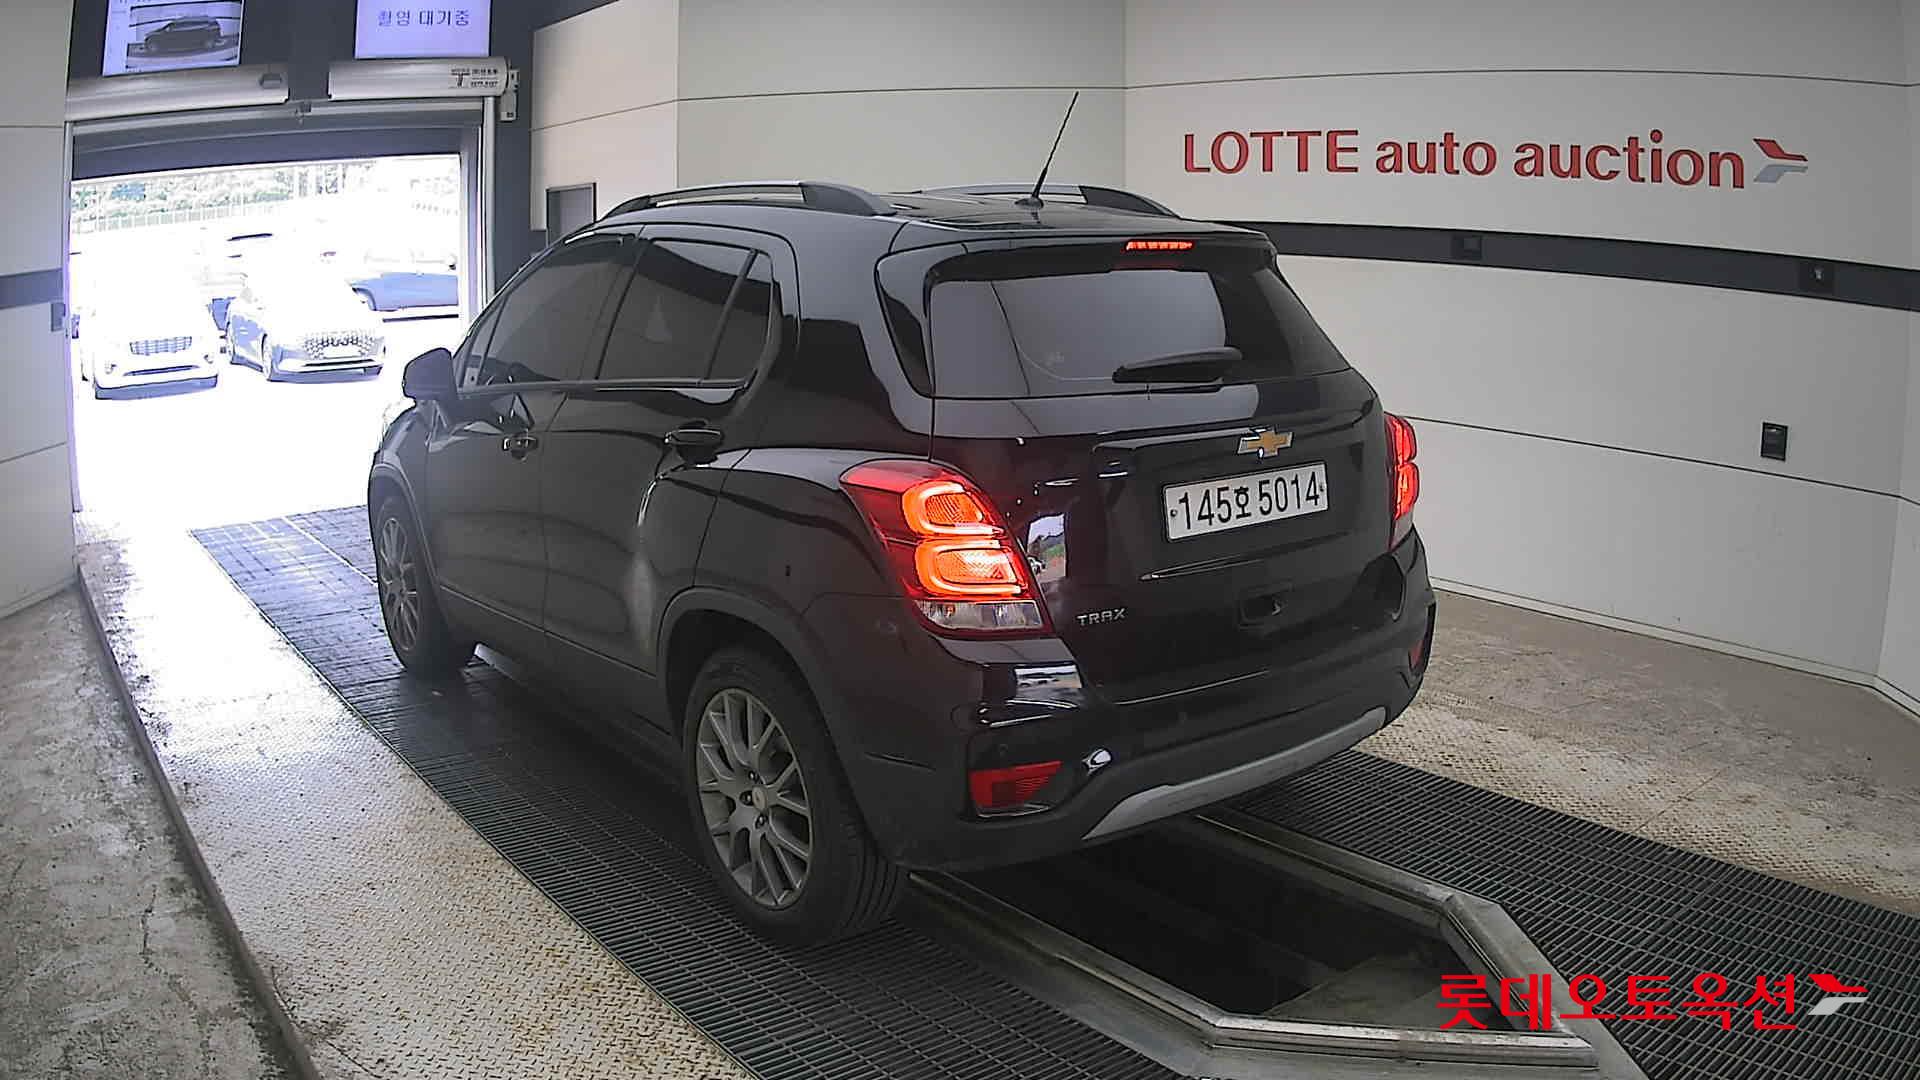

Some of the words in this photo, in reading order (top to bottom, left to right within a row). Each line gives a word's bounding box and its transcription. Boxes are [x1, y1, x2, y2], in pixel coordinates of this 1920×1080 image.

[419, 9, 469, 26] 대기중
[1184, 129, 1359, 173] LOTTE
[1375, 131, 1498, 176] auto
[1513, 129, 1745, 189] auction
[1178, 486, 1252, 530] 145호
[1258, 471, 1320, 516] 5014
[1076, 608, 1126, 626] TRAX
